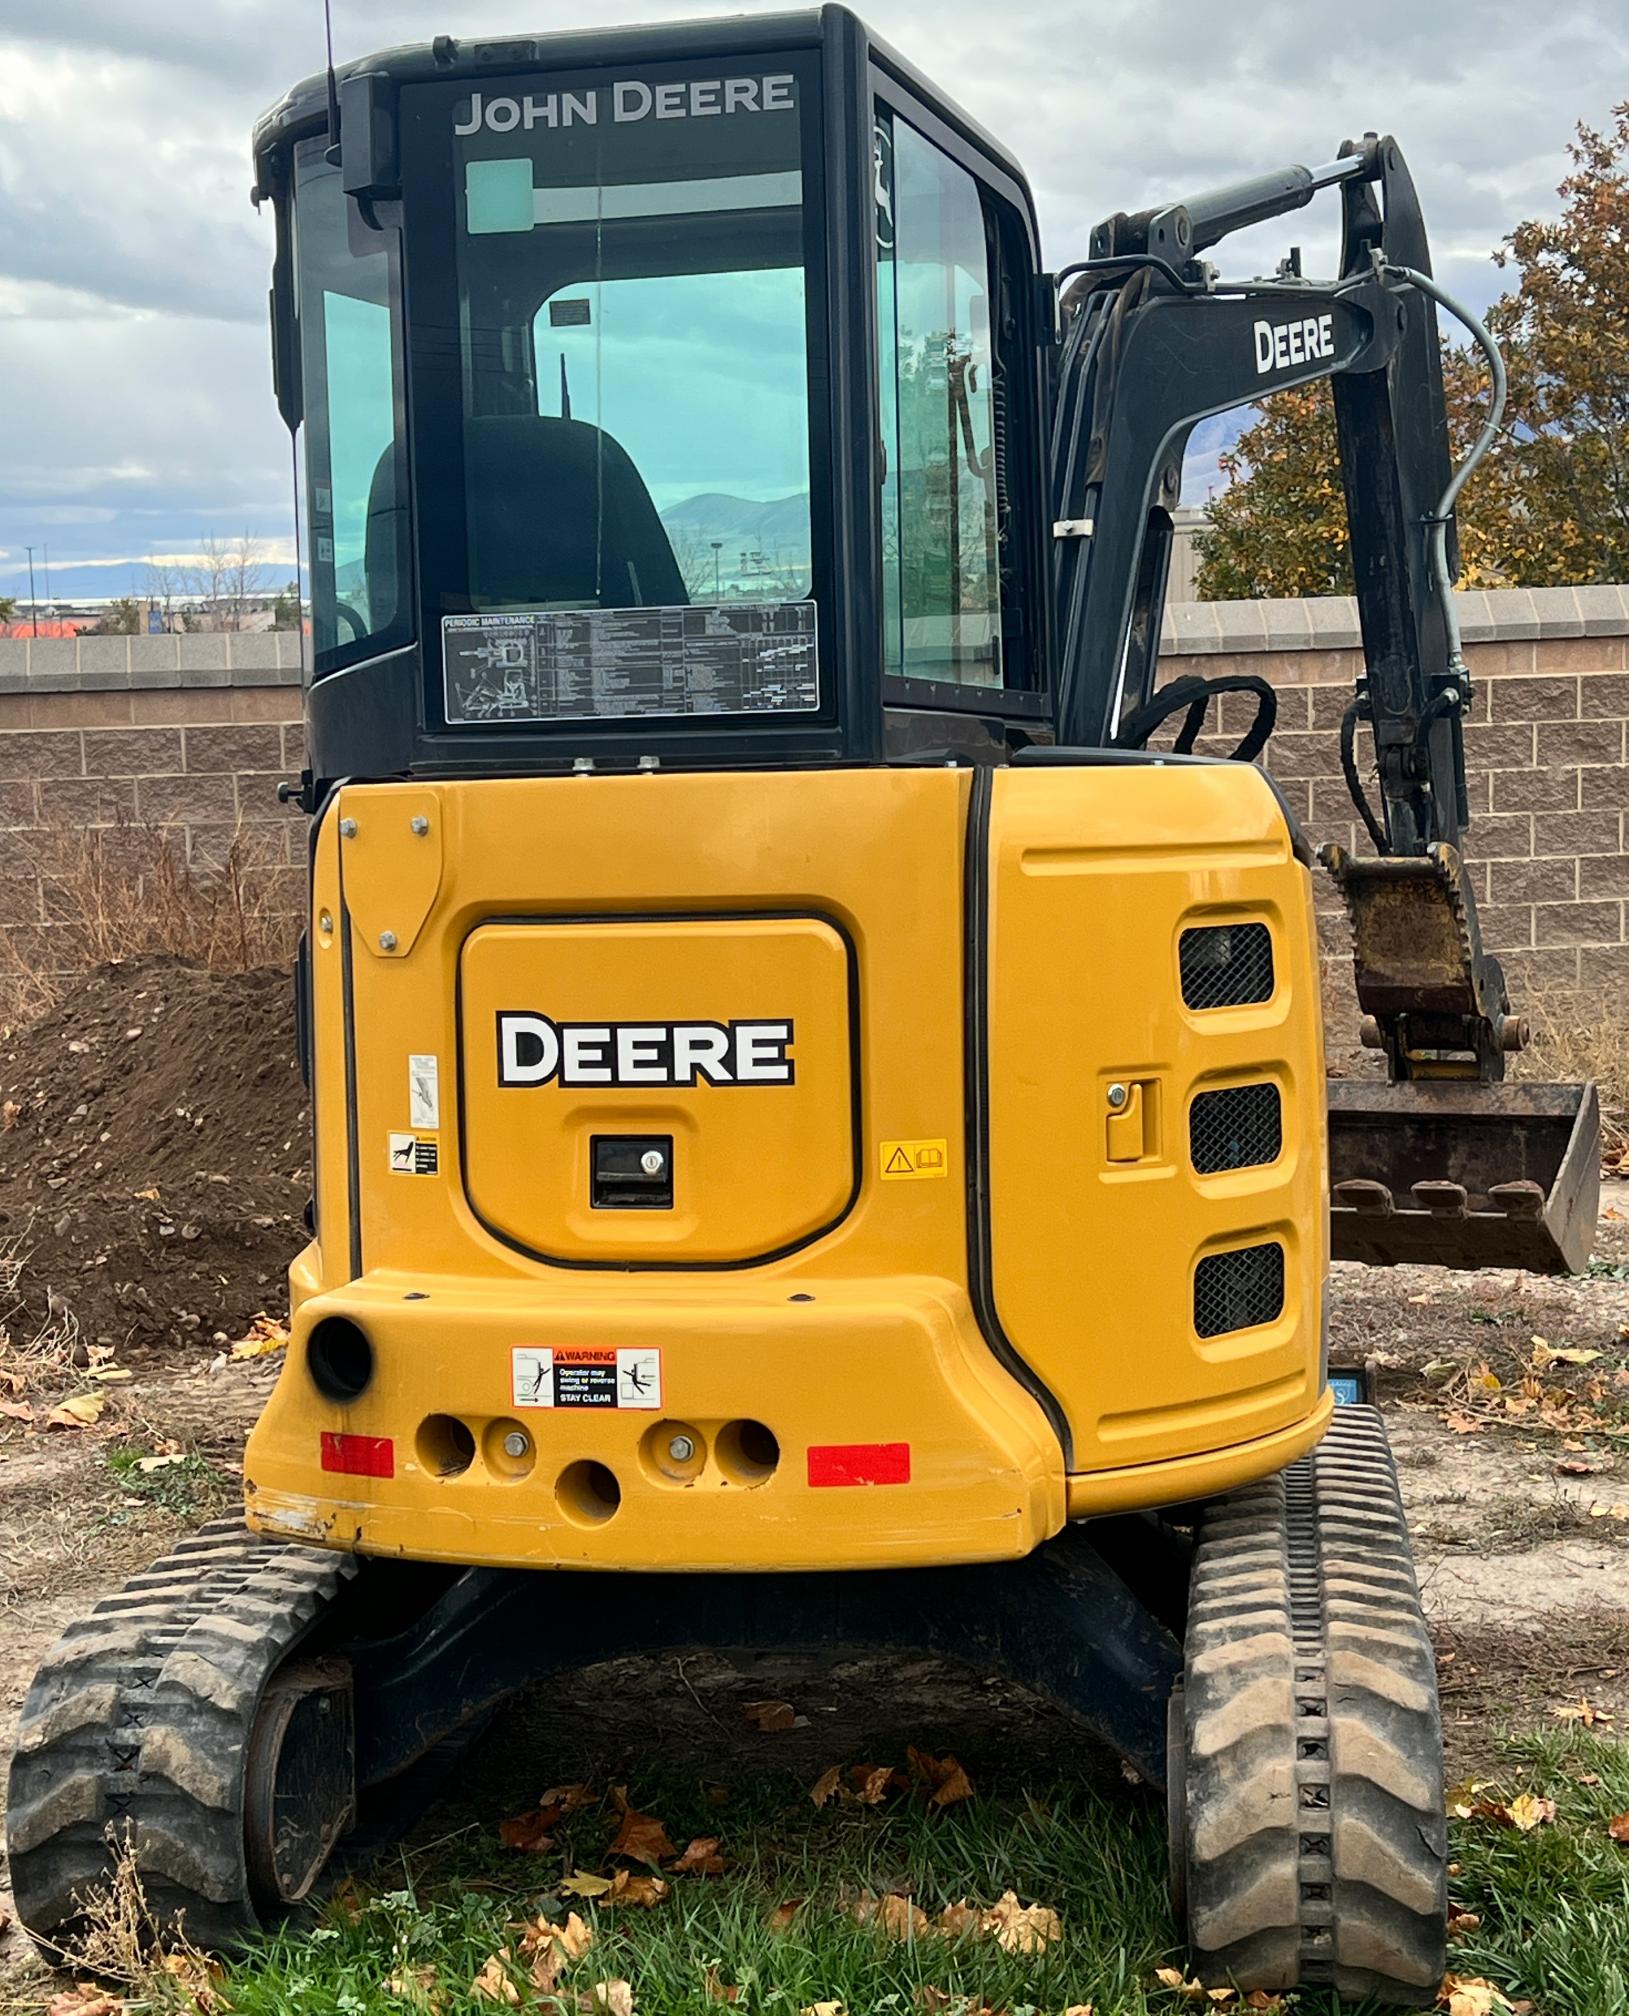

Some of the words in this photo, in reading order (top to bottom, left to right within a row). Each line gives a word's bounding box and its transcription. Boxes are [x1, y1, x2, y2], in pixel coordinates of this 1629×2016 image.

[455, 91, 597, 136] JOHN
[613, 74, 795, 123] DEERE
[1254, 314, 1335, 374] DEERE
[445, 617, 480, 628] PERIODIC
[482, 615, 535, 626] MAINTENANCE
[500, 1016, 790, 1082] DEERE
[566, 1351, 615, 1361] WARNING
[559, 1368, 589, 1377] Operator
[560, 1393, 581, 1402] STAY
[582, 1393, 611, 1402] CLEAR
